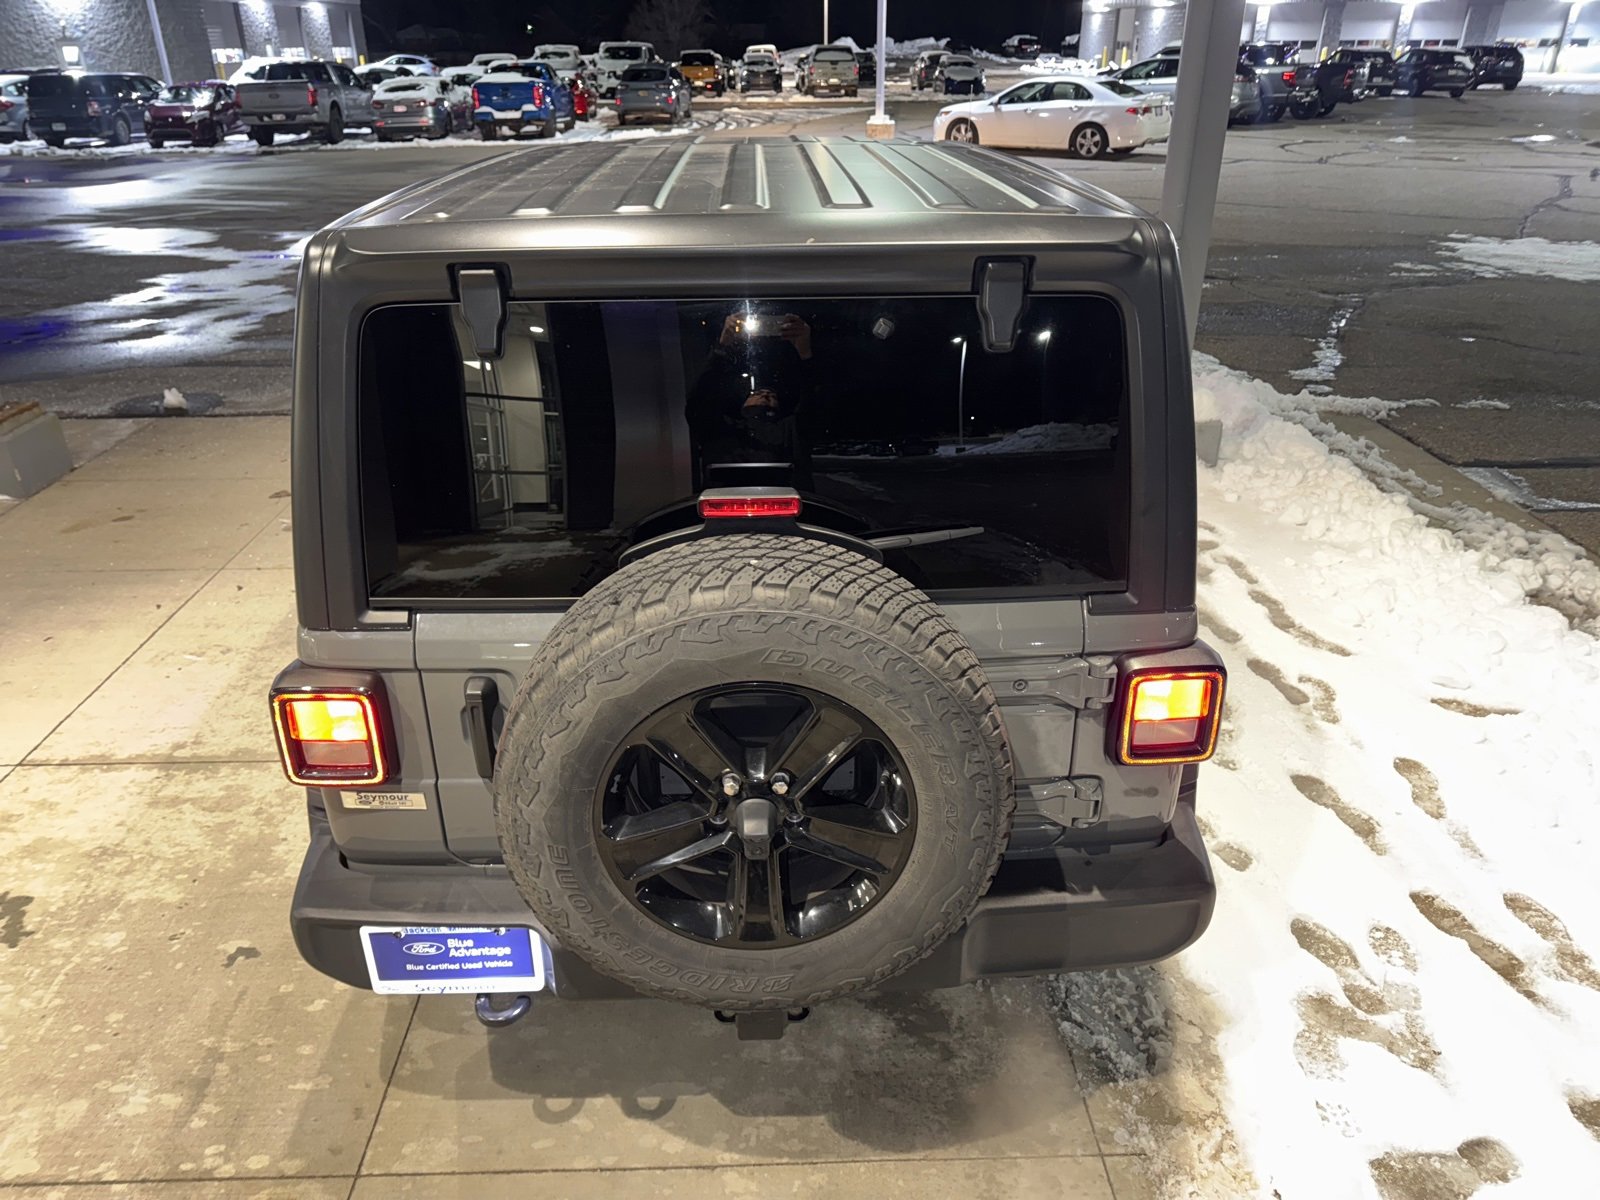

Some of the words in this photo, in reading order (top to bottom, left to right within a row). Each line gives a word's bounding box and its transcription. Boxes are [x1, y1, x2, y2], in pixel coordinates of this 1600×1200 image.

[760, 648, 959, 786] DUELER
[356, 791, 409, 802] Seymour
[547, 844, 795, 994] BRIDGESTONE
[411, 943, 437, 954] Ford
[447, 938, 474, 949] Blue
[449, 946, 512, 958] Advantage
[406, 963, 424, 971] Blue
[425, 962, 460, 971] Certified
[461, 961, 483, 970] Used
[484, 959, 513, 969] Vehicle
